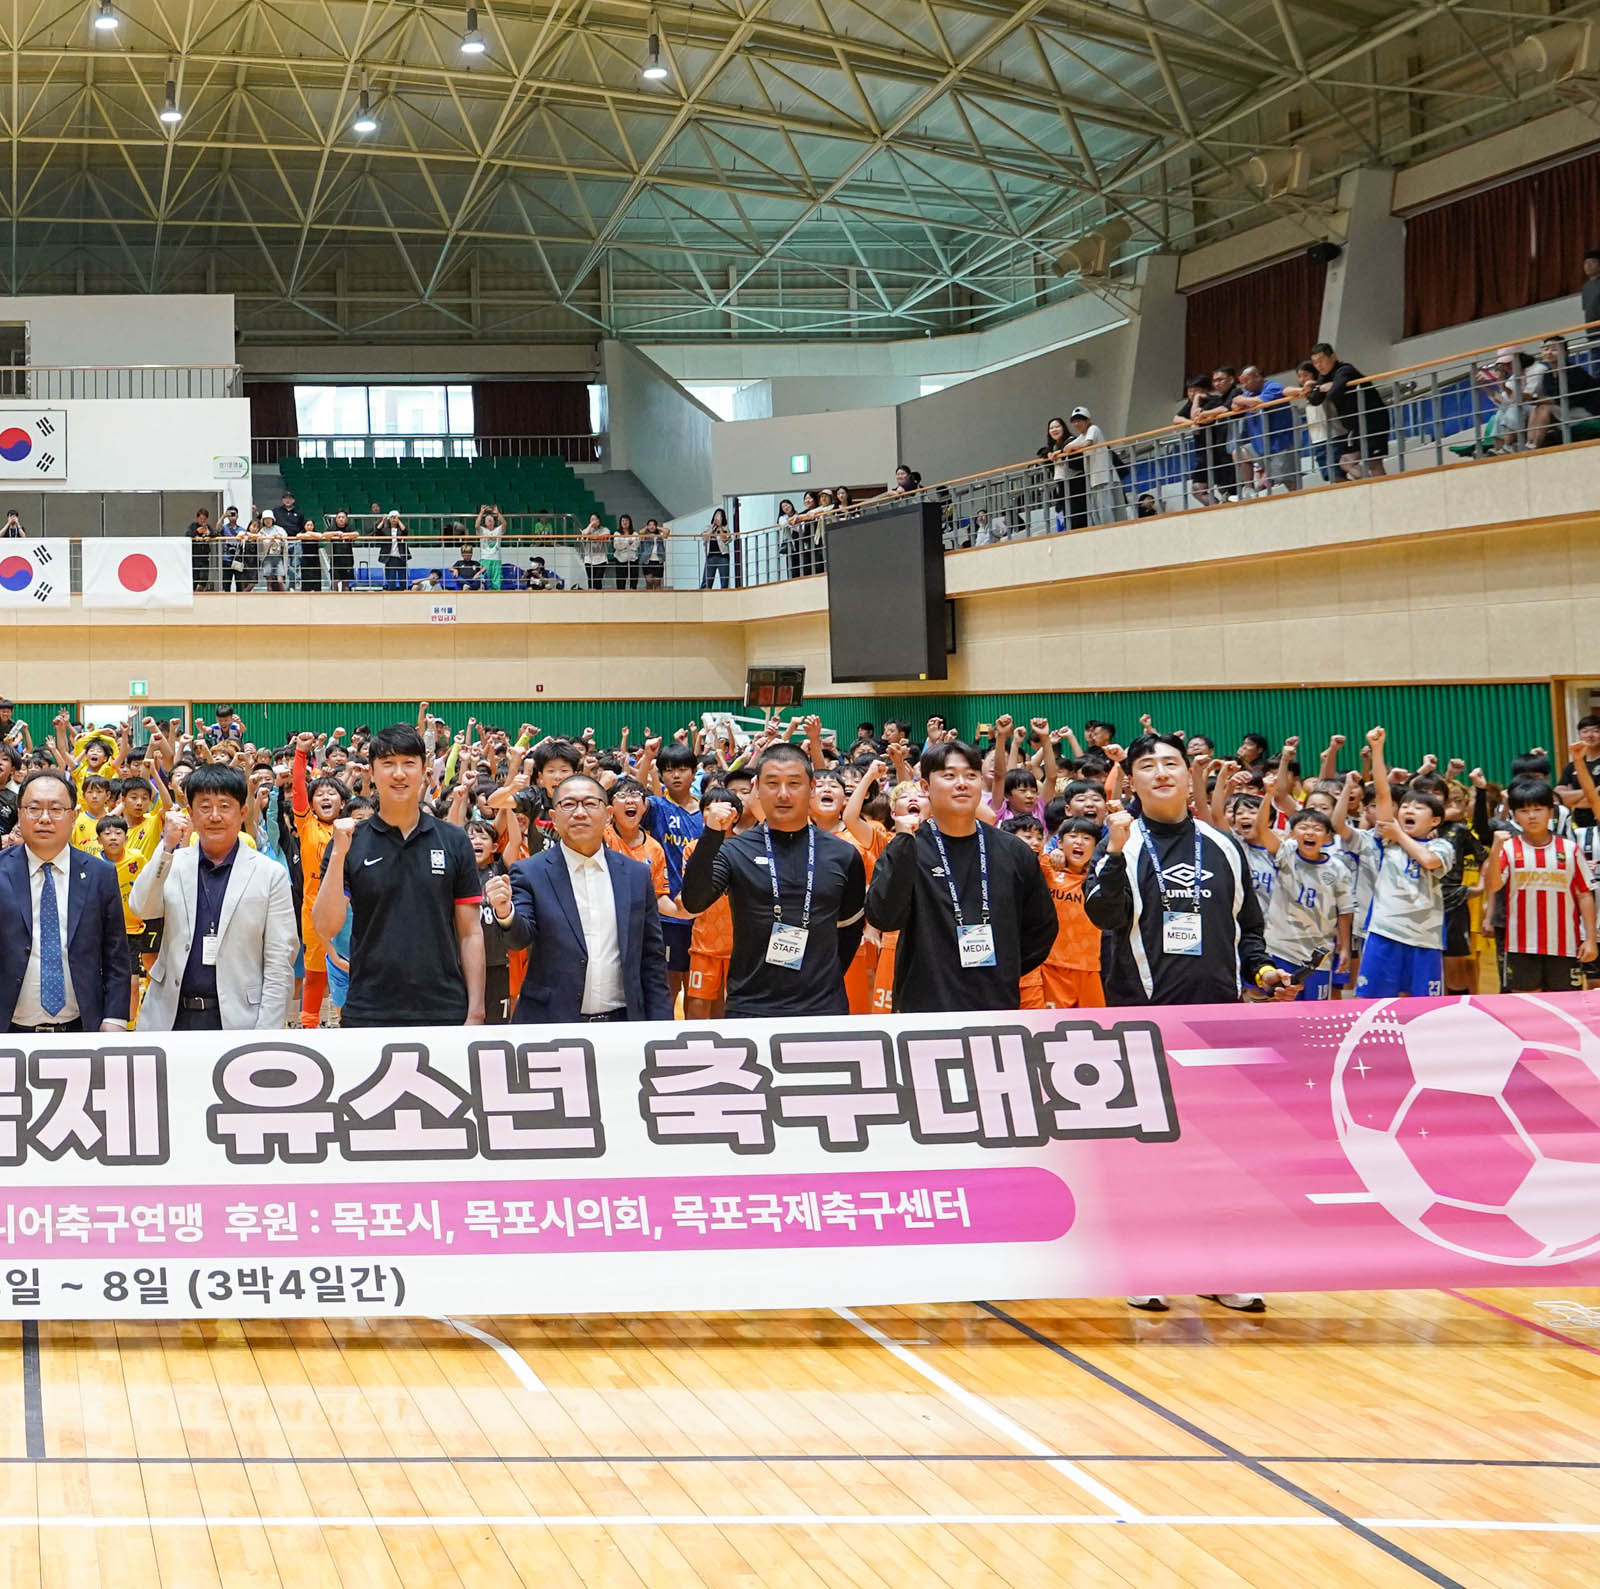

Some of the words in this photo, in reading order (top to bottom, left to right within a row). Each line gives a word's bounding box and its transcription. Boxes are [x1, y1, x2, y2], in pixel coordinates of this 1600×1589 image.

[668, 815, 680, 828] 21
[664, 833, 689, 847] MUA
[1296, 882, 1316, 908] 18
[148, 932, 158, 948] 7
[1167, 932, 1198, 940] MEDIA
[772, 942, 800, 955] STAFF
[962, 944, 991, 953] MEDIA
[1428, 980, 1440, 997] 23
[206, 1038, 606, 1164] 유소년
[639, 1020, 1181, 1155] 축구대회
[224, 1201, 298, 1242] 후원
[331, 1199, 454, 1246] 목포시,
[464, 1194, 662, 1240] 목포시의회,
[672, 1187, 971, 1235] 목포국제축구센터
[102, 1266, 169, 1306] 8일
[189, 1265, 406, 1309] (3박4일간)
